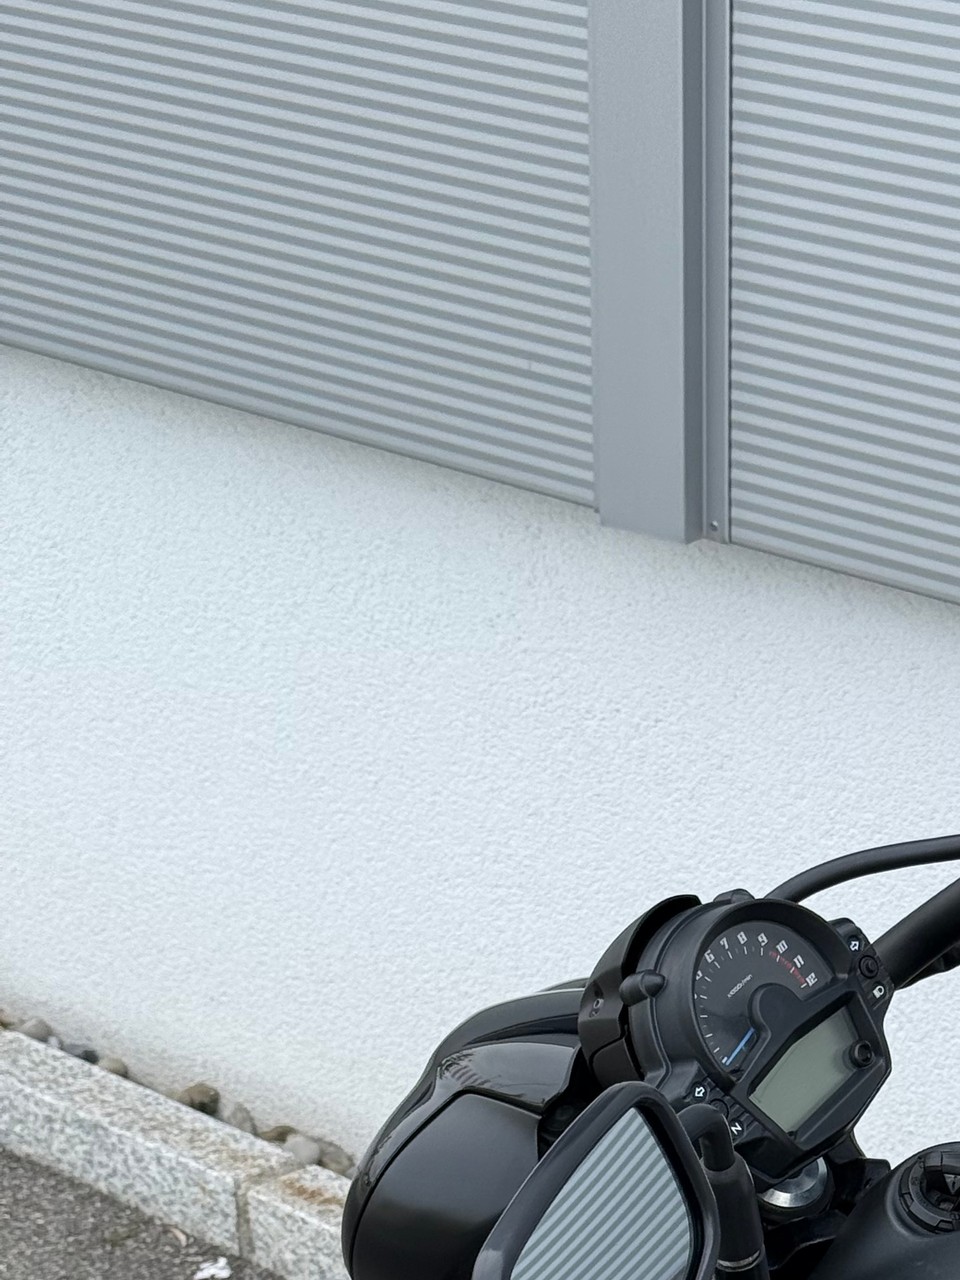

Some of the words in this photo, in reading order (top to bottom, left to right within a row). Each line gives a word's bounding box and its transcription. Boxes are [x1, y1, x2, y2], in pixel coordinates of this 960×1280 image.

[719, 936, 729, 950] 7
[736, 930, 748, 945] 8
[756, 931, 769, 947] 9
[775, 939, 789, 955] 10
[703, 948, 716, 964] 6
[792, 954, 805, 969] 11
[804, 971, 819, 988] 12
[731, 1123, 742, 1135] N
